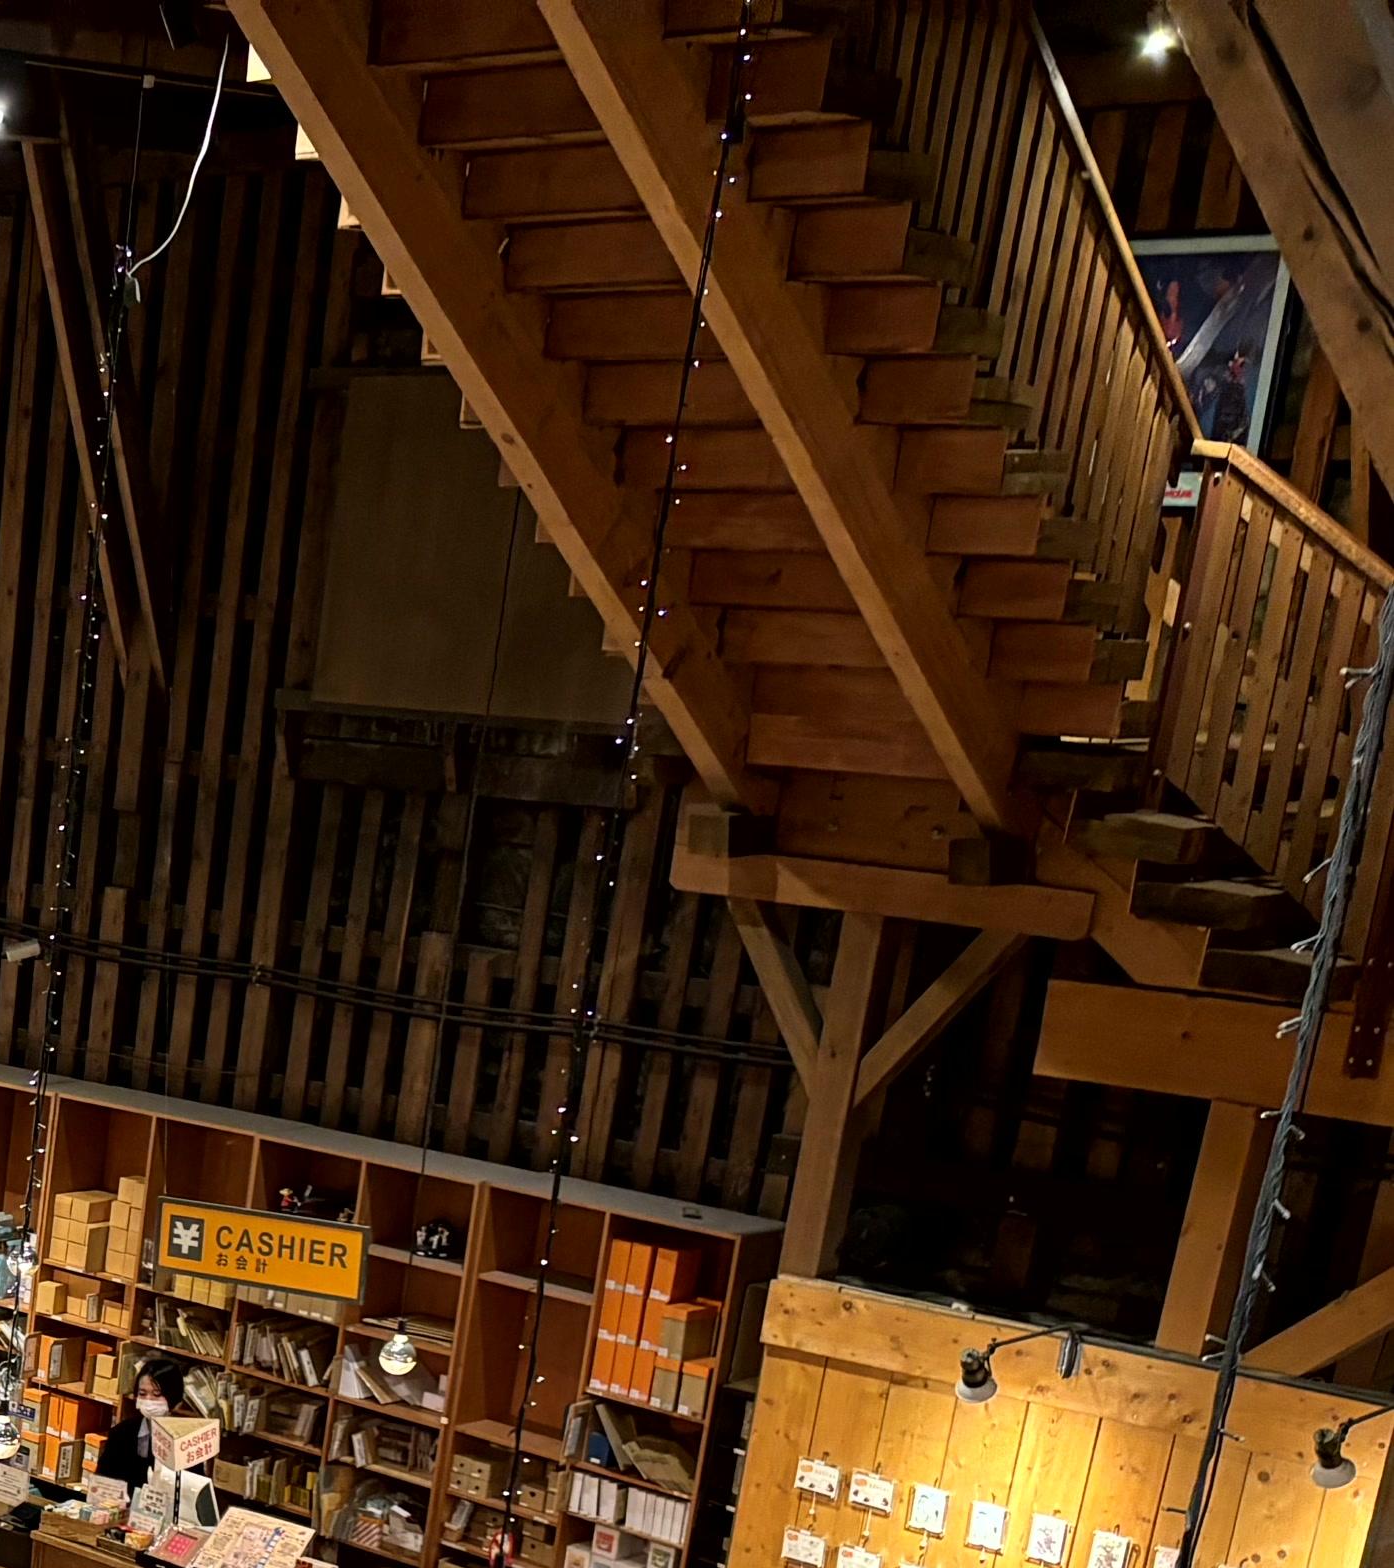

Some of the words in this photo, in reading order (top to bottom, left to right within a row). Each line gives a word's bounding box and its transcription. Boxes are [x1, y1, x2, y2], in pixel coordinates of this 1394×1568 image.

[215, 1225, 349, 1270] CASHIER
[215, 1253, 269, 1275] お会計
[180, 1427, 217, 1452] CASHIER
[186, 1442, 212, 1463] お会計
